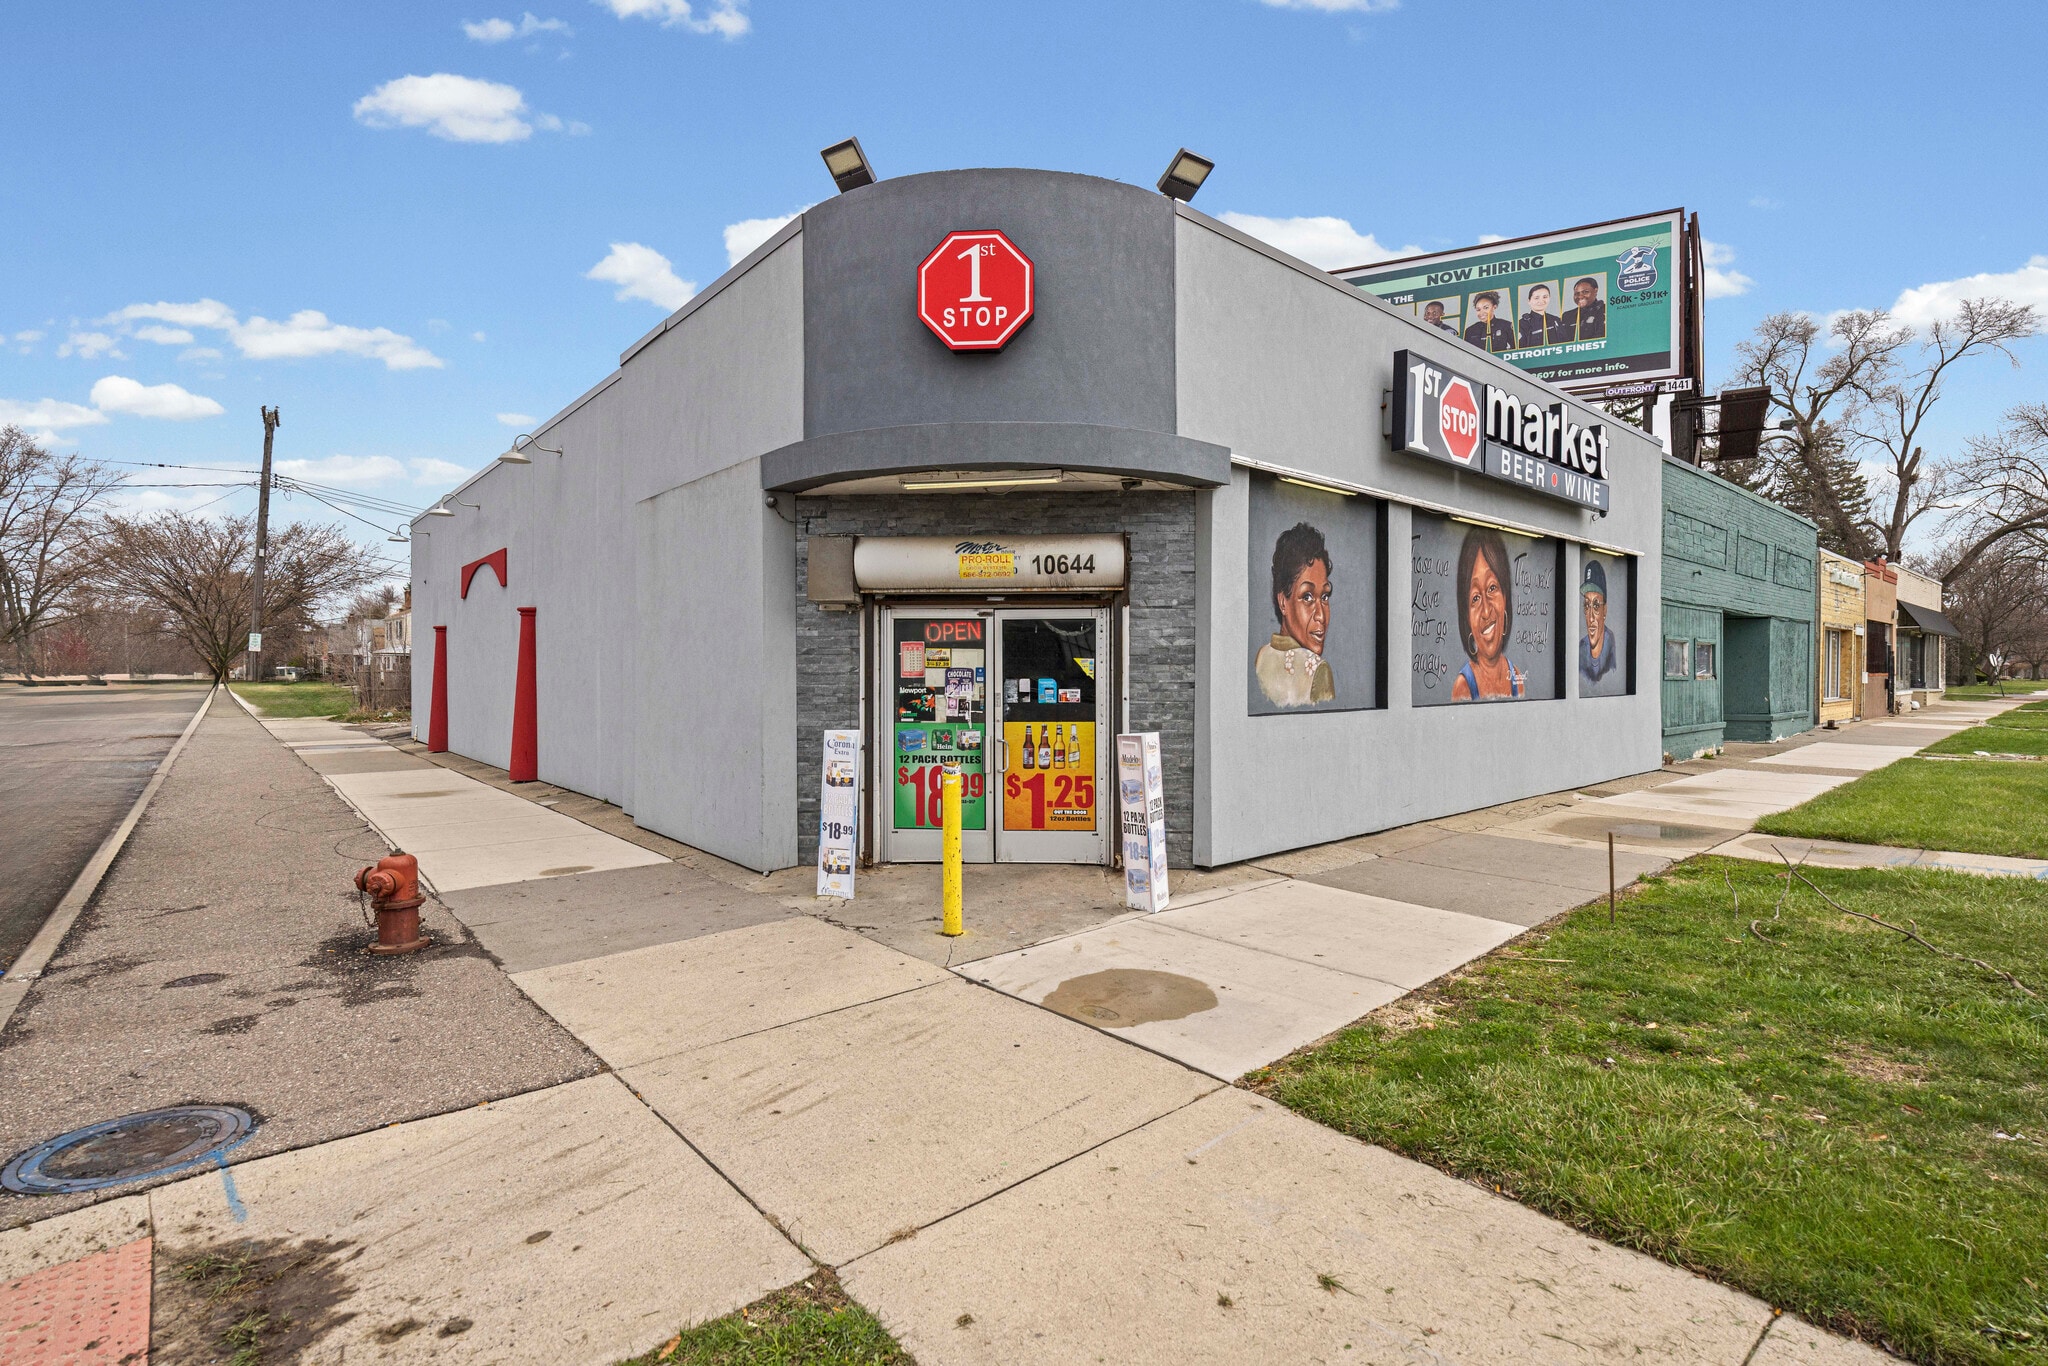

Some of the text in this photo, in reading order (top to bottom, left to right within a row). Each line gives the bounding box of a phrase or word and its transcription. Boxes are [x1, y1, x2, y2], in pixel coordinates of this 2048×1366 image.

[957, 243, 997, 303] 1st
[1426, 256, 1544, 286] NOW HIRING
[1624, 276, 1651, 284] POLICE
[1393, 294, 1414, 304] THE
[943, 306, 1008, 328] STOP
[1396, 272, 1607, 353] EAM
[1503, 340, 1607, 361] DETROIT'S FINEST
[1557, 369, 1573, 377] for
[1575, 366, 1602, 375] more
[1605, 363, 1629, 372] info.
[1667, 380, 1690, 392] 1441
[1409, 363, 1477, 453] 1ST STOP
[1486, 384, 1609, 480] market
[1501, 450, 1600, 506] BEER WINE
[955, 541, 1007, 554] Motor
[961, 555, 1011, 565] PRO-ROLL
[1032, 554, 1096, 575] 10644
[1436, 559, 1449, 577] we
[1514, 552, 1532, 595] They
[1412, 578, 1440, 613] Love
[1540, 602, 1549, 616] us
[926, 622, 982, 641] OPEN
[1435, 621, 1448, 646] go
[1413, 653, 1441, 689] away
[899, 686, 927, 695] Newport
[827, 739, 855, 749] Corona
[899, 755, 982, 764] 12 PACK BOTTLES
[1006, 773, 1094, 829] $1.25
[1123, 811, 1146, 824] 12 PACK
[822, 821, 853, 840] $18.99
[1123, 823, 1147, 837] BOTTLES
